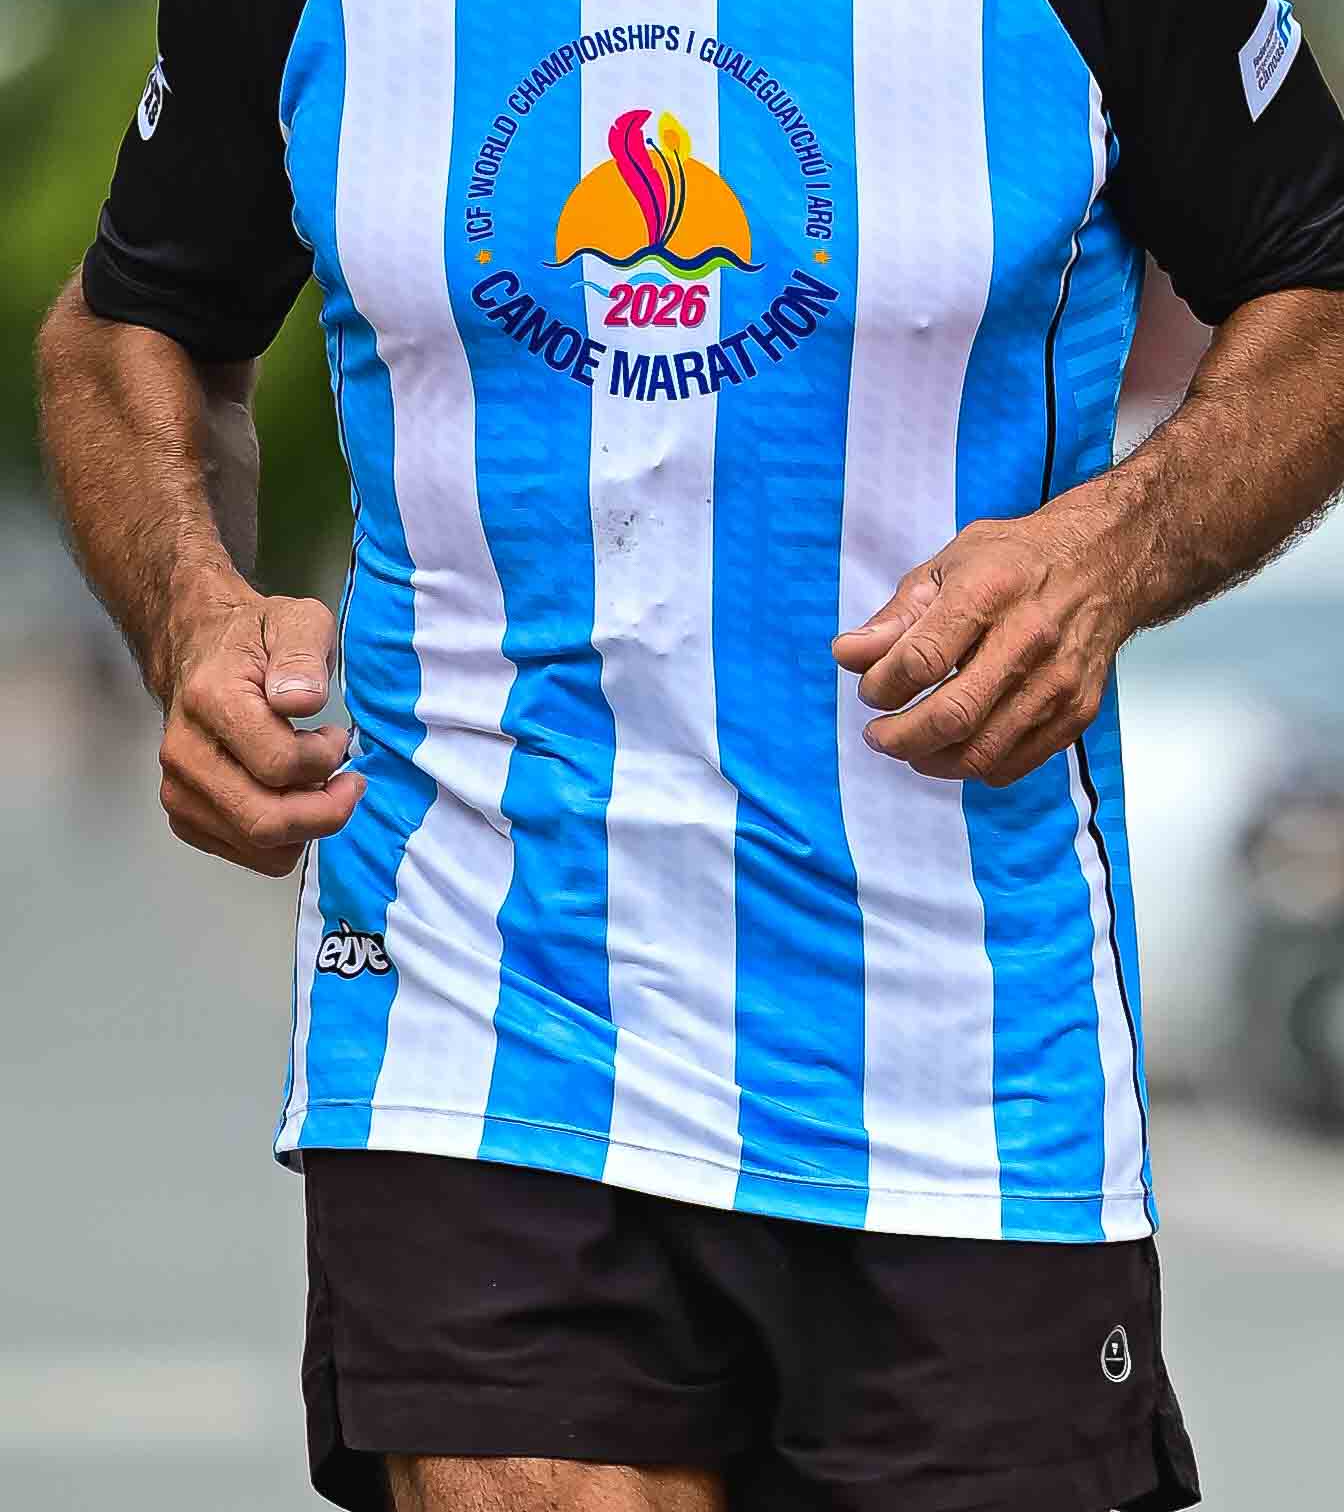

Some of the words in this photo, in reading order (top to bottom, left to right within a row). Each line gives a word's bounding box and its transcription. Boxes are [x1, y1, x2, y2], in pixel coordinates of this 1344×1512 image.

[507, 24, 681, 116] CHAMPIONSHIPS
[700, 37, 833, 178] GUALEGUAYCHÚ
[467, 115, 518, 201] WORLD
[466, 207, 494, 243] ICF
[805, 194, 832, 240] ARG
[470, 269, 608, 388] CANOE
[608, 269, 841, 402] MARATHON
[603, 283, 711, 329] 2026
